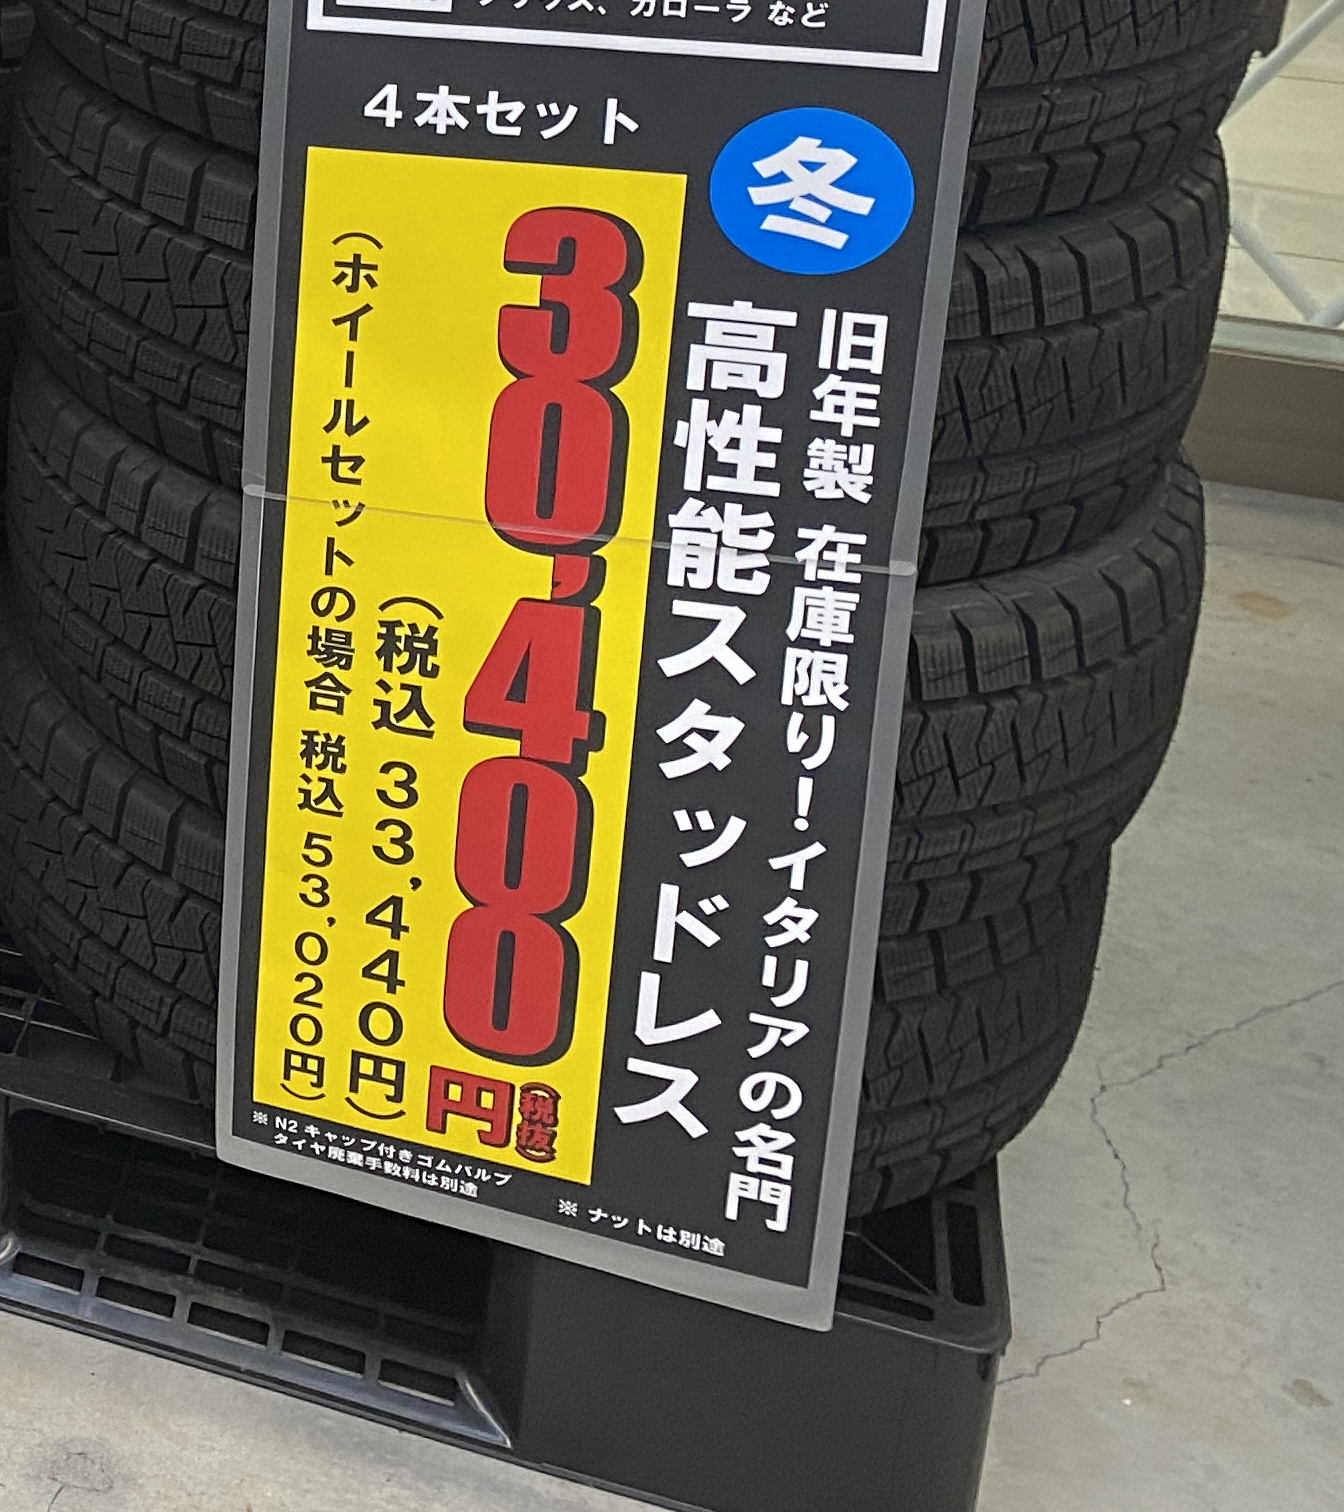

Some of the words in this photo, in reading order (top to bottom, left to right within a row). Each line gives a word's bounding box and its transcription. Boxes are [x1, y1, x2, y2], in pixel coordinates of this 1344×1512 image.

[767, 0, 829, 30] など
[362, 82, 641, 146] 4本セット
[746, 134, 877, 251] 冬
[802, 308, 891, 505] 旧年製
[612, 300, 800, 1141] 高性能スタッドレス
[587, 1205, 727, 1259] ナットは別途
